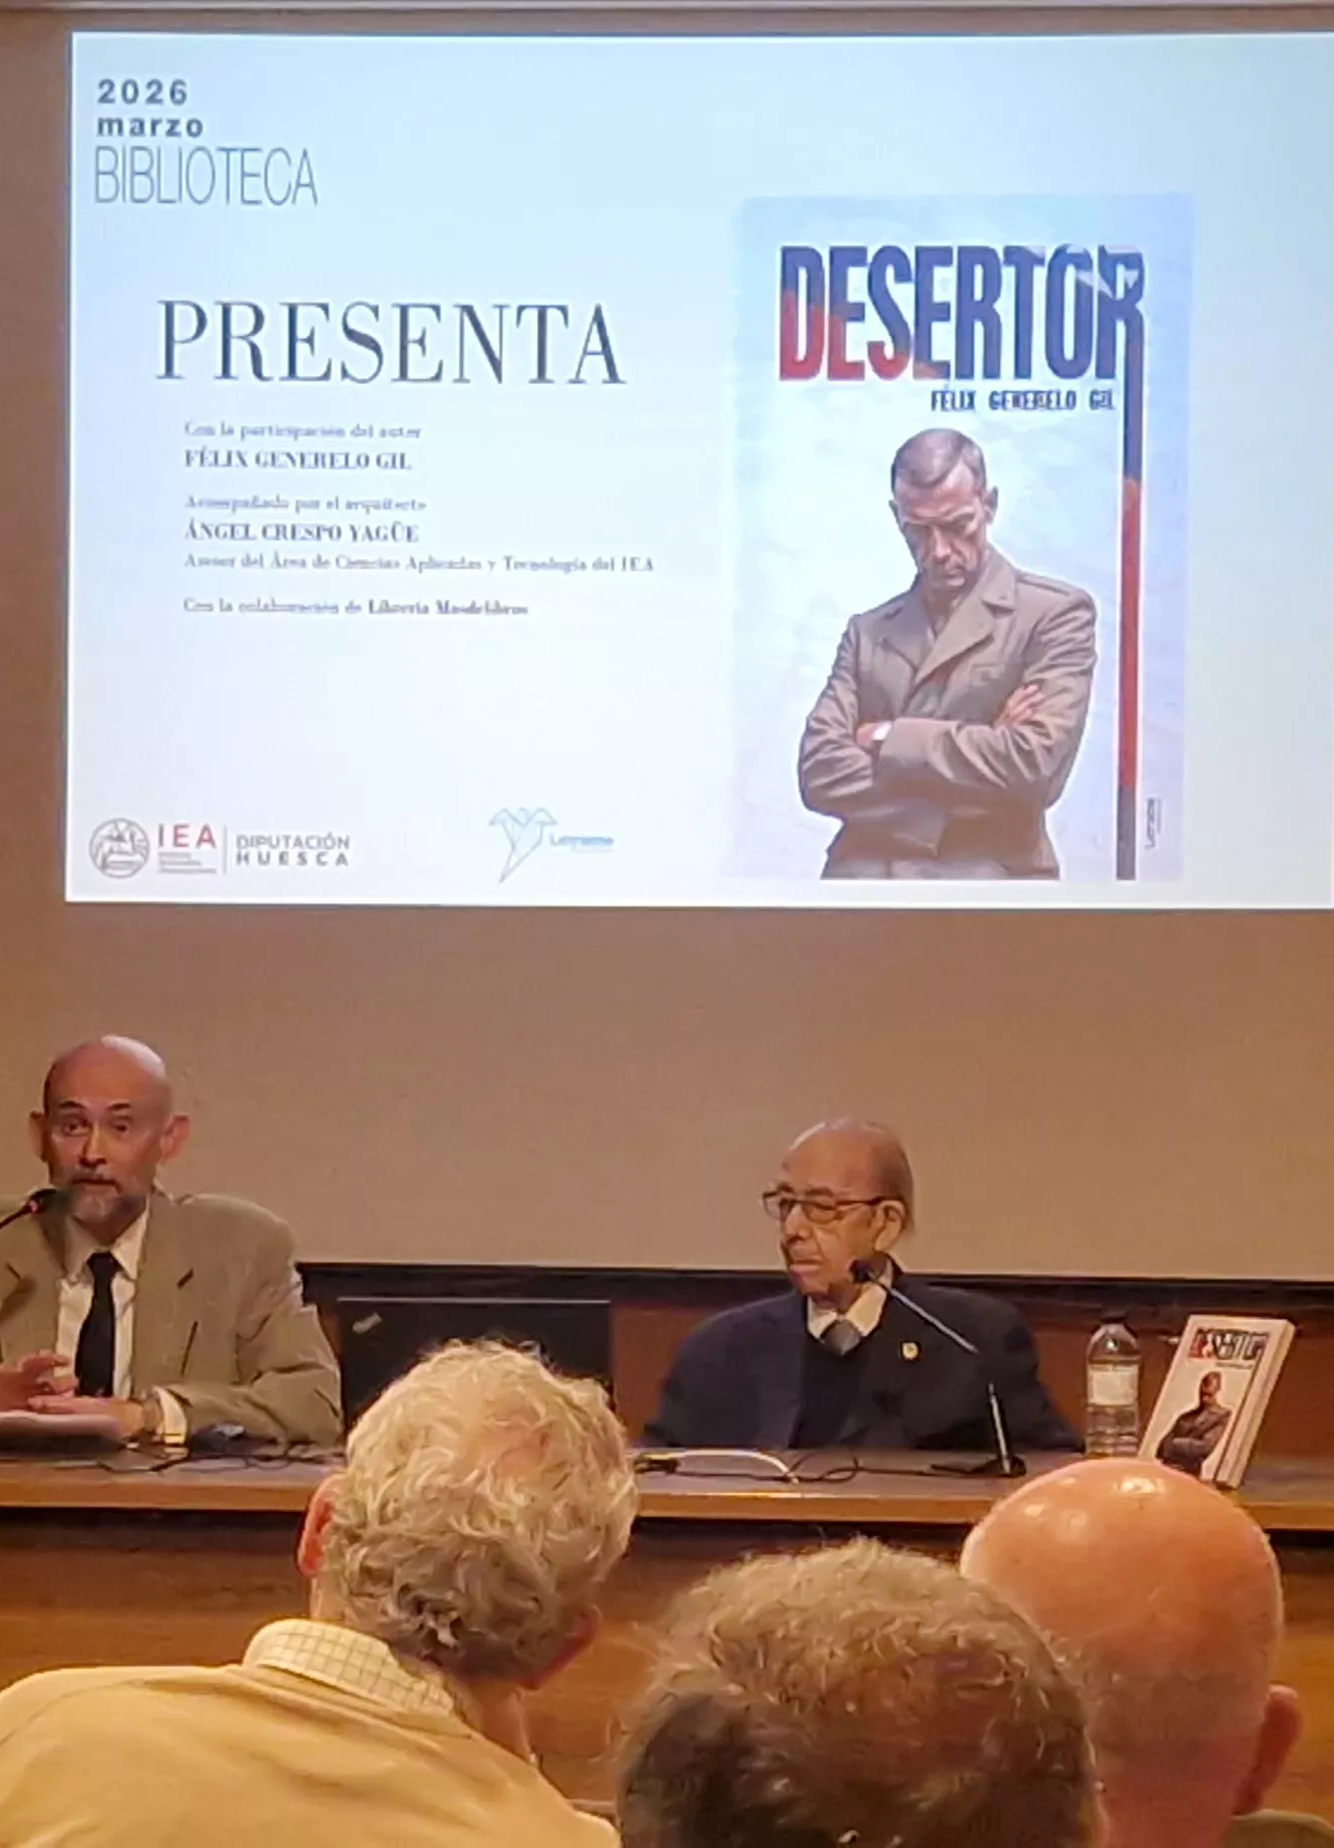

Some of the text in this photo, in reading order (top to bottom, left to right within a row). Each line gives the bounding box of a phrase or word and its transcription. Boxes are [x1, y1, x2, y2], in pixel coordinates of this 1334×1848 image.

[97, 78, 189, 105] 2026
[97, 115, 204, 139] marzo
[94, 145, 319, 206] BIBLIOTECA
[779, 244, 1145, 382] DESERTOR
[155, 299, 627, 385] PRESENTA
[931, 384, 1115, 411] FÉLIX GENERELO GIL
[184, 421, 216, 437] Con
[220, 421, 234, 437] la
[350, 423, 374, 438] del
[379, 426, 422, 438] autor
[184, 446, 413, 470] FÉLIX GENERELO GIL
[184, 495, 427, 515] Acompañado por el arquitecto
[184, 517, 420, 543] ÁNGEL CRESPO YAGÜE
[184, 550, 654, 575] Asesor del Área de Ciencias Aplicadas y Tecnología del IEA
[183, 598, 214, 613] Con
[219, 598, 233, 613] la
[238, 597, 339, 614] colaboración
[344, 600, 362, 614] de
[158, 823, 217, 849] IEA
[236, 832, 350, 850] DIPUTACIÓN
[236, 851, 349, 867] HUESCA
